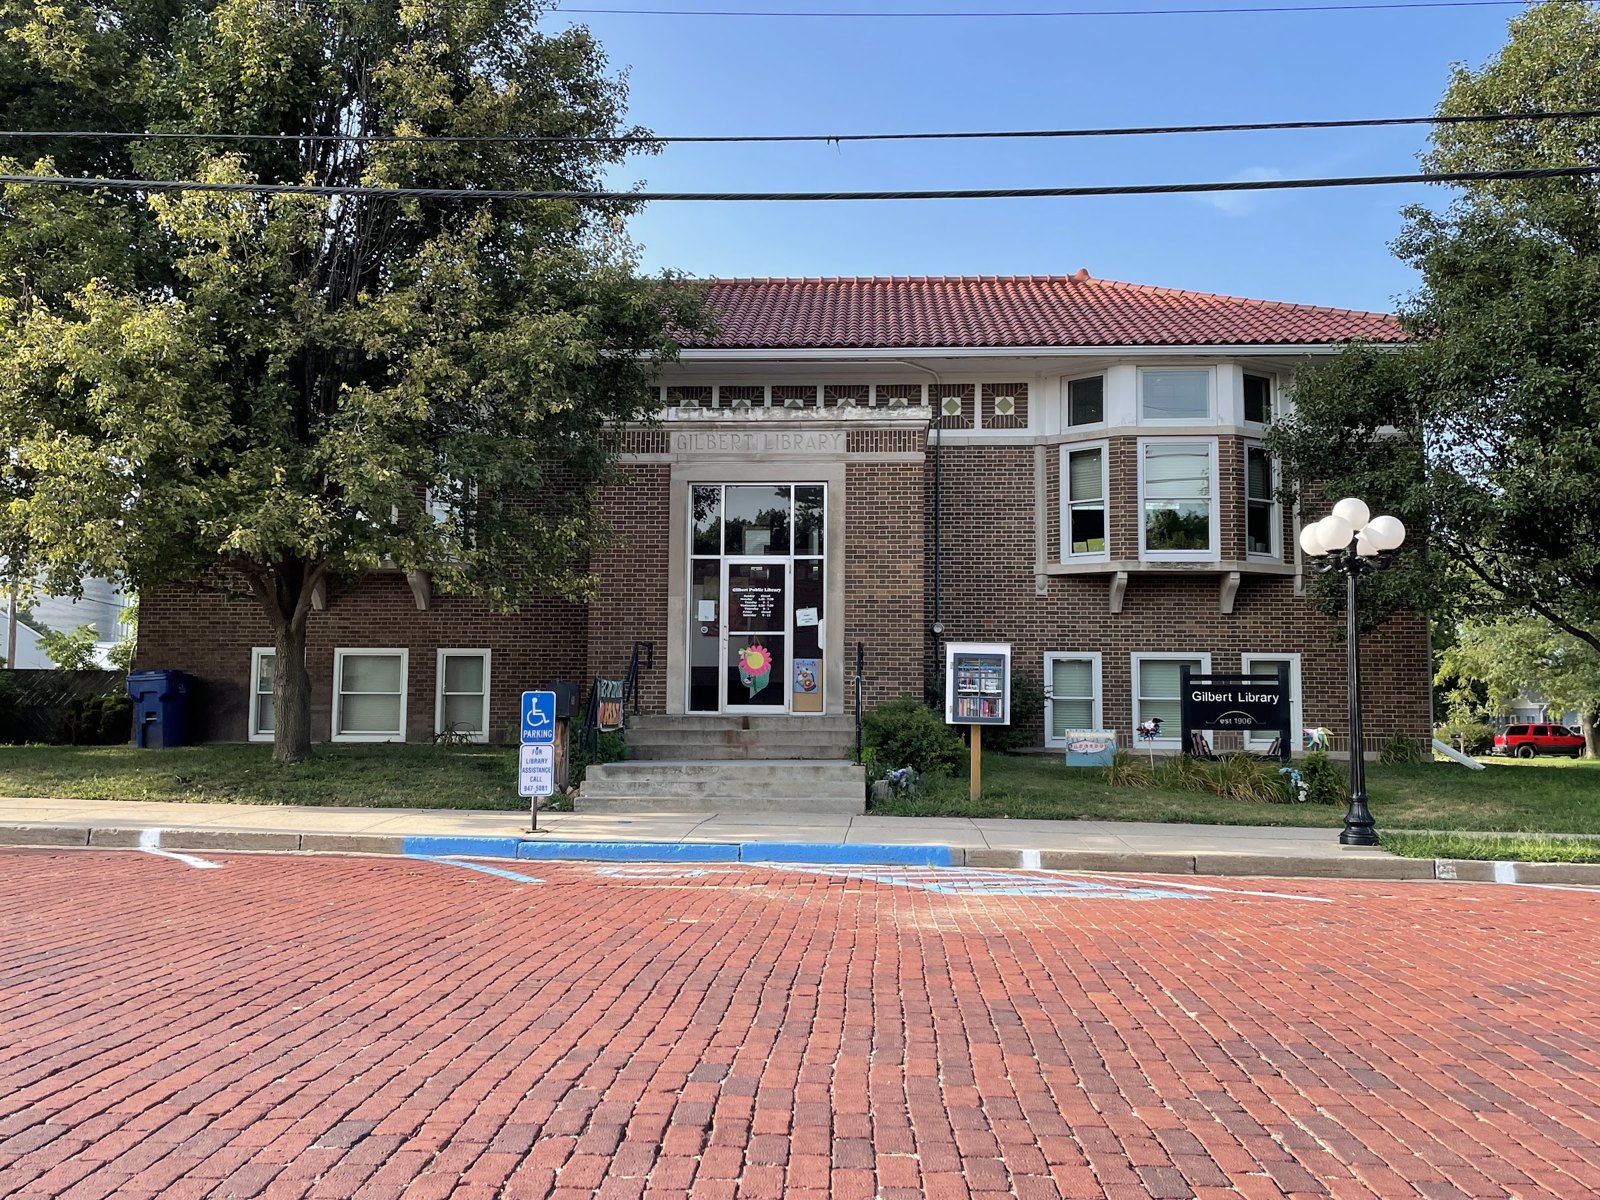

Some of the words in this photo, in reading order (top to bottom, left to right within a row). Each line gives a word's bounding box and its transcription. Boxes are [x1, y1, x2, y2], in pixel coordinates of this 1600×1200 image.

[677, 433, 753, 450] GILBERT
[762, 433, 842, 450] LIBRARY
[1191, 691, 1233, 702] Gilbert
[1238, 691, 1280, 705] Library
[523, 730, 552, 738] PARKING
